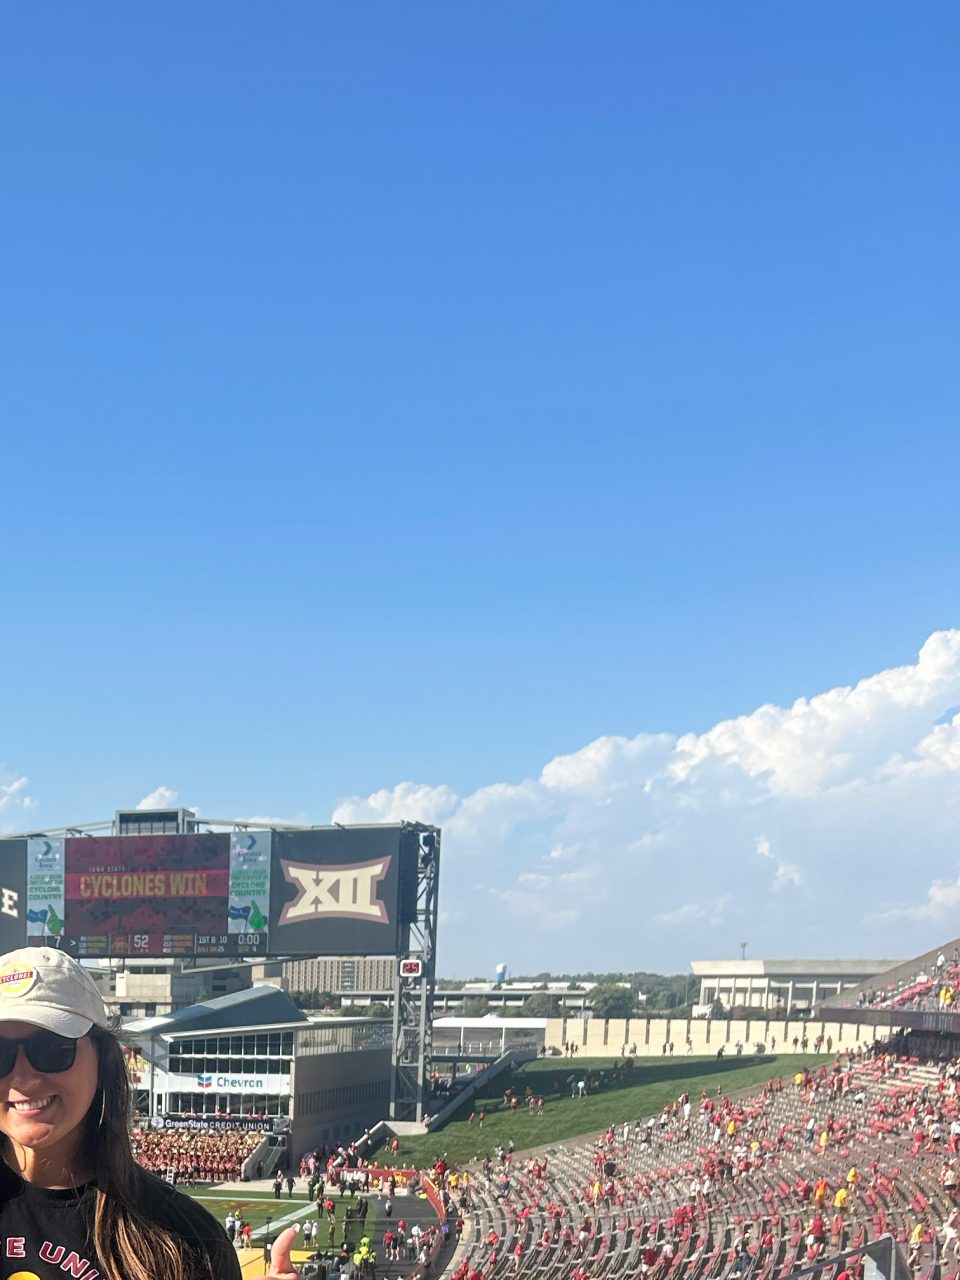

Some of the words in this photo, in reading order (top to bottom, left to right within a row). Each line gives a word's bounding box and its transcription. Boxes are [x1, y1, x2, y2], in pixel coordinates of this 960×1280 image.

[80, 873, 165, 897] CYCLONES
[169, 872, 207, 896] WIN
[54, 935, 61, 948] 7
[133, 935, 149, 948] 52
[199, 936, 210, 944] 1ST
[219, 935, 228, 944] 10
[237, 934, 260, 945] 0:00
[403, 962, 418, 974] 25
[217, 1076, 263, 1087] Chevron
[165, 1119, 208, 1129] GreenState
[209, 1121, 240, 1130] CREDIT
[243, 1122, 270, 1131] UNION
